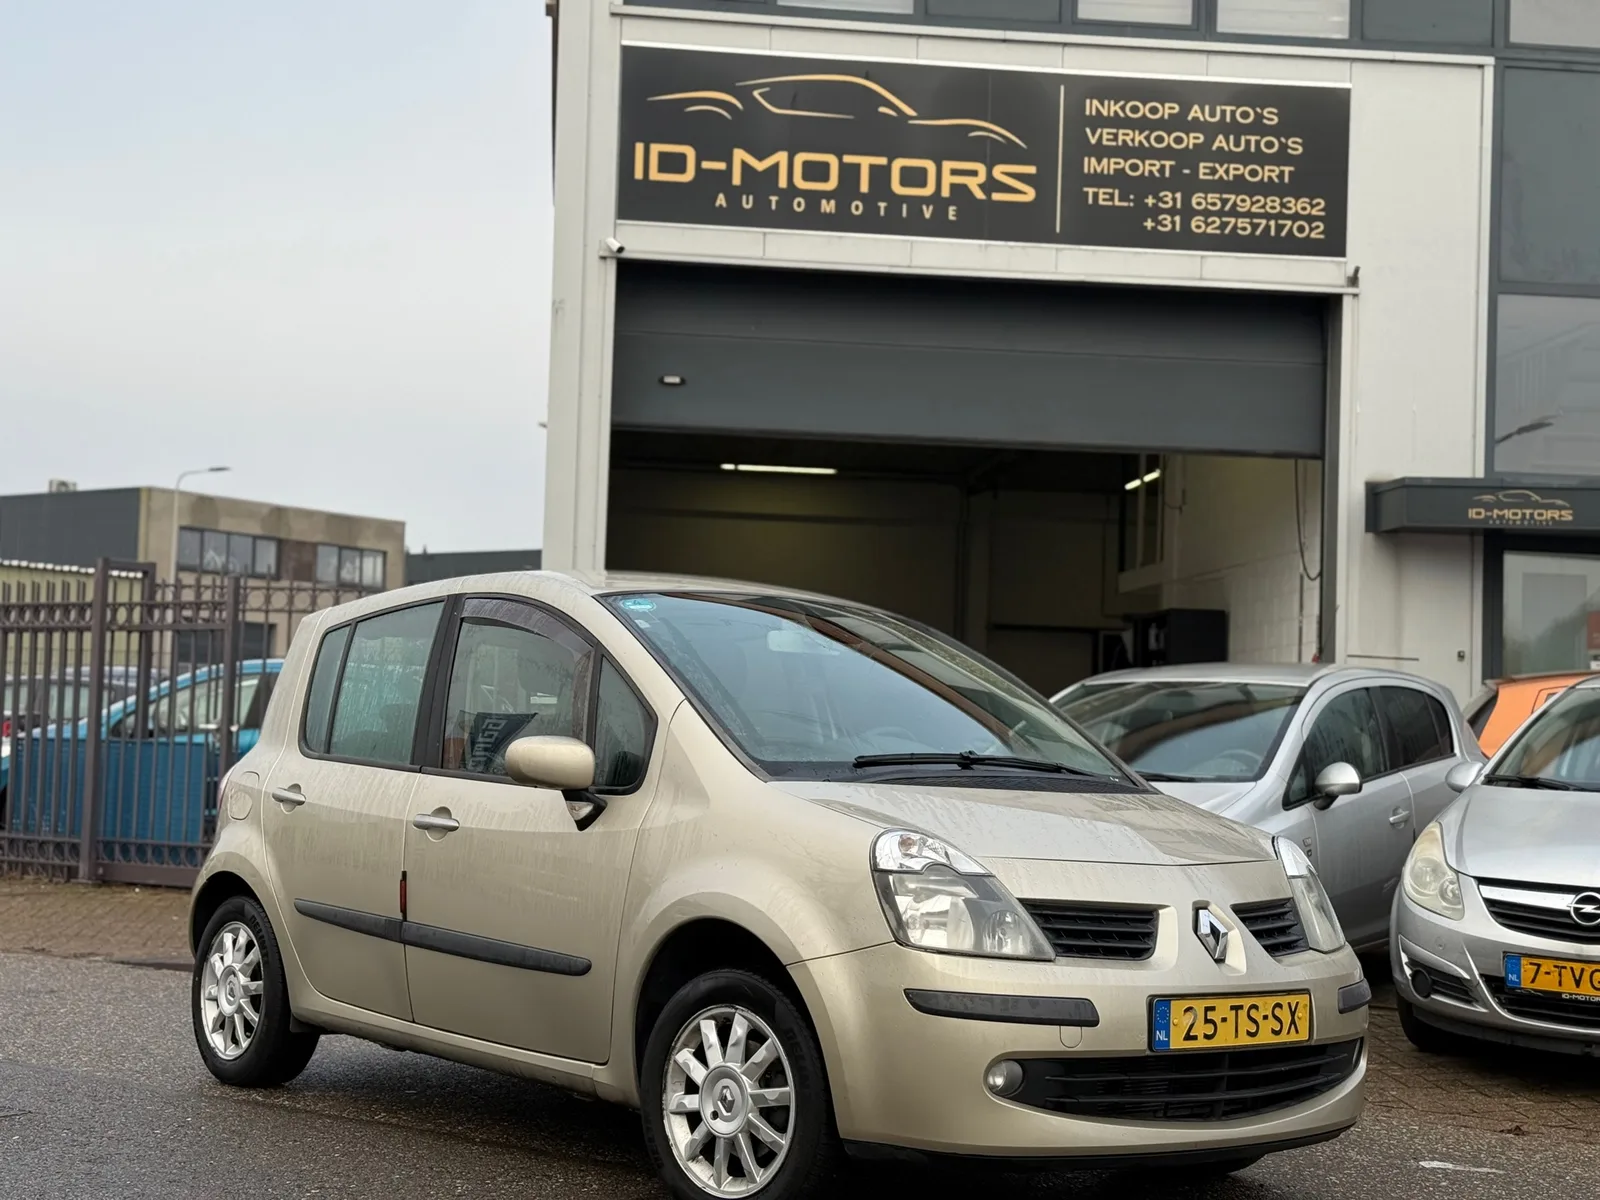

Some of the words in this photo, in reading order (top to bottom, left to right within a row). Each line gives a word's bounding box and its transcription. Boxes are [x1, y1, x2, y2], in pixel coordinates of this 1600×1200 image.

[1084, 98, 1181, 120] INKOOP
[1084, 127, 1205, 150] VERKOOP
[633, 141, 1038, 203] ID-MOTORS
[1083, 156, 1176, 178] IMPORT
[1198, 161, 1295, 184] EXPORT
[714, 192, 958, 221] AUTOMOTIVE
[1082, 186, 1135, 207] TEL:
[1143, 190, 1182, 210] +31
[1190, 192, 1326, 216] 657928362
[1142, 214, 1181, 232] +31
[1190, 215, 1325, 239] 627571702
[1468, 507, 1573, 521] ID-MOTORS
[1508, 973, 1519, 982] NL
[1182, 1001, 1300, 1042] 25-TS-SX
[1155, 1030, 1169, 1041] NL
